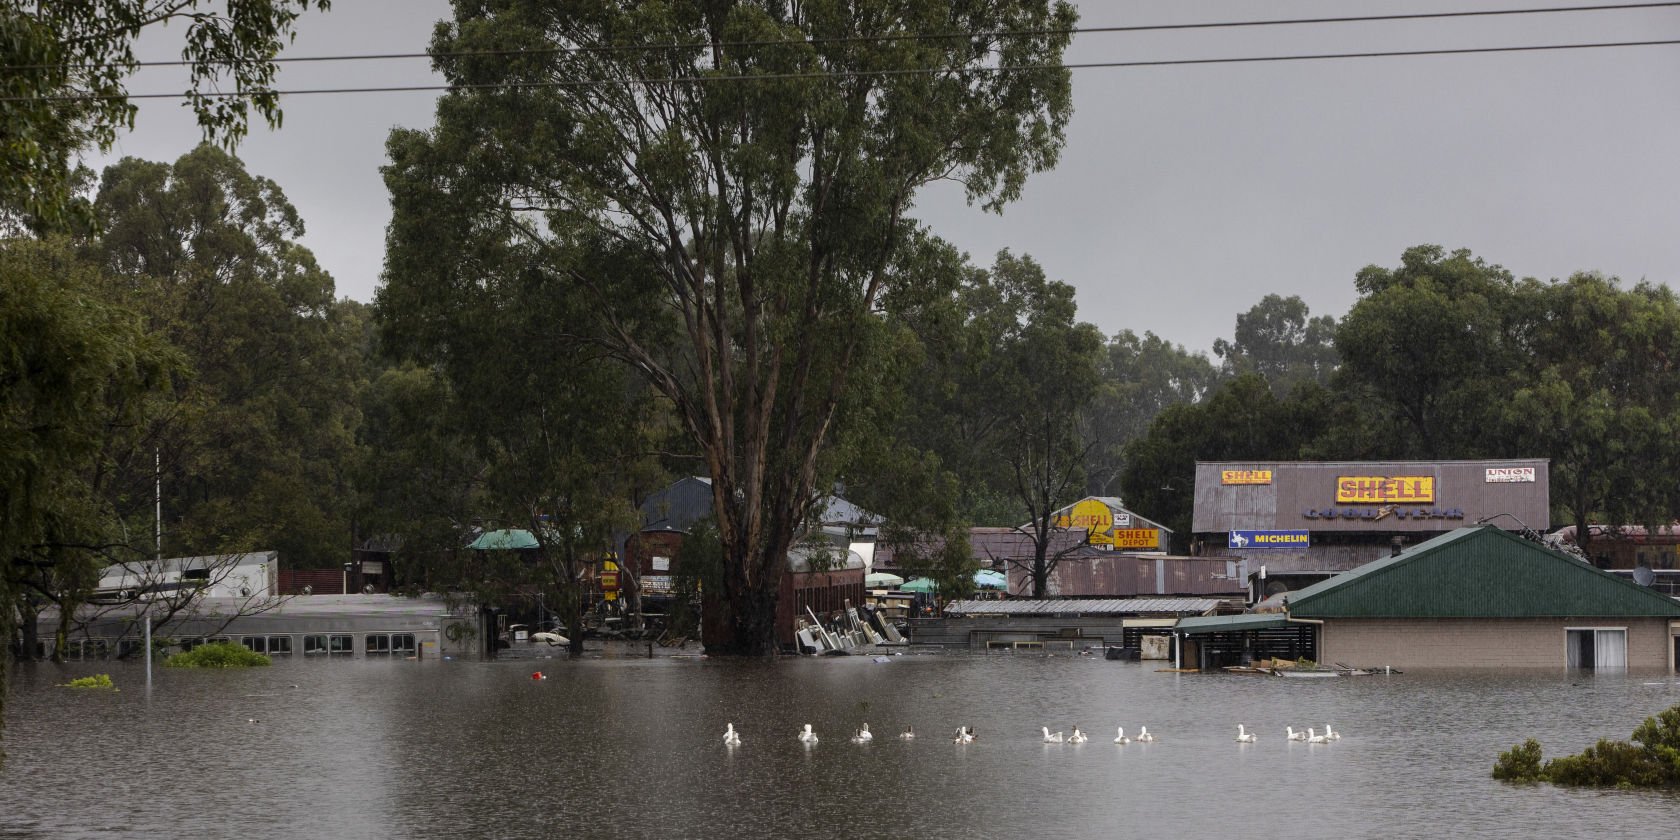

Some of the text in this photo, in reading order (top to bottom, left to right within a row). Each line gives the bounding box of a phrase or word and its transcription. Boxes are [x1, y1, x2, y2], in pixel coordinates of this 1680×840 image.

[1225, 471, 1268, 480] SHELL
[1341, 480, 1430, 498] SHELL
[1076, 515, 1109, 526] SHELL
[1118, 530, 1154, 539] SHELL
[1255, 535, 1307, 543] MICHELIN
